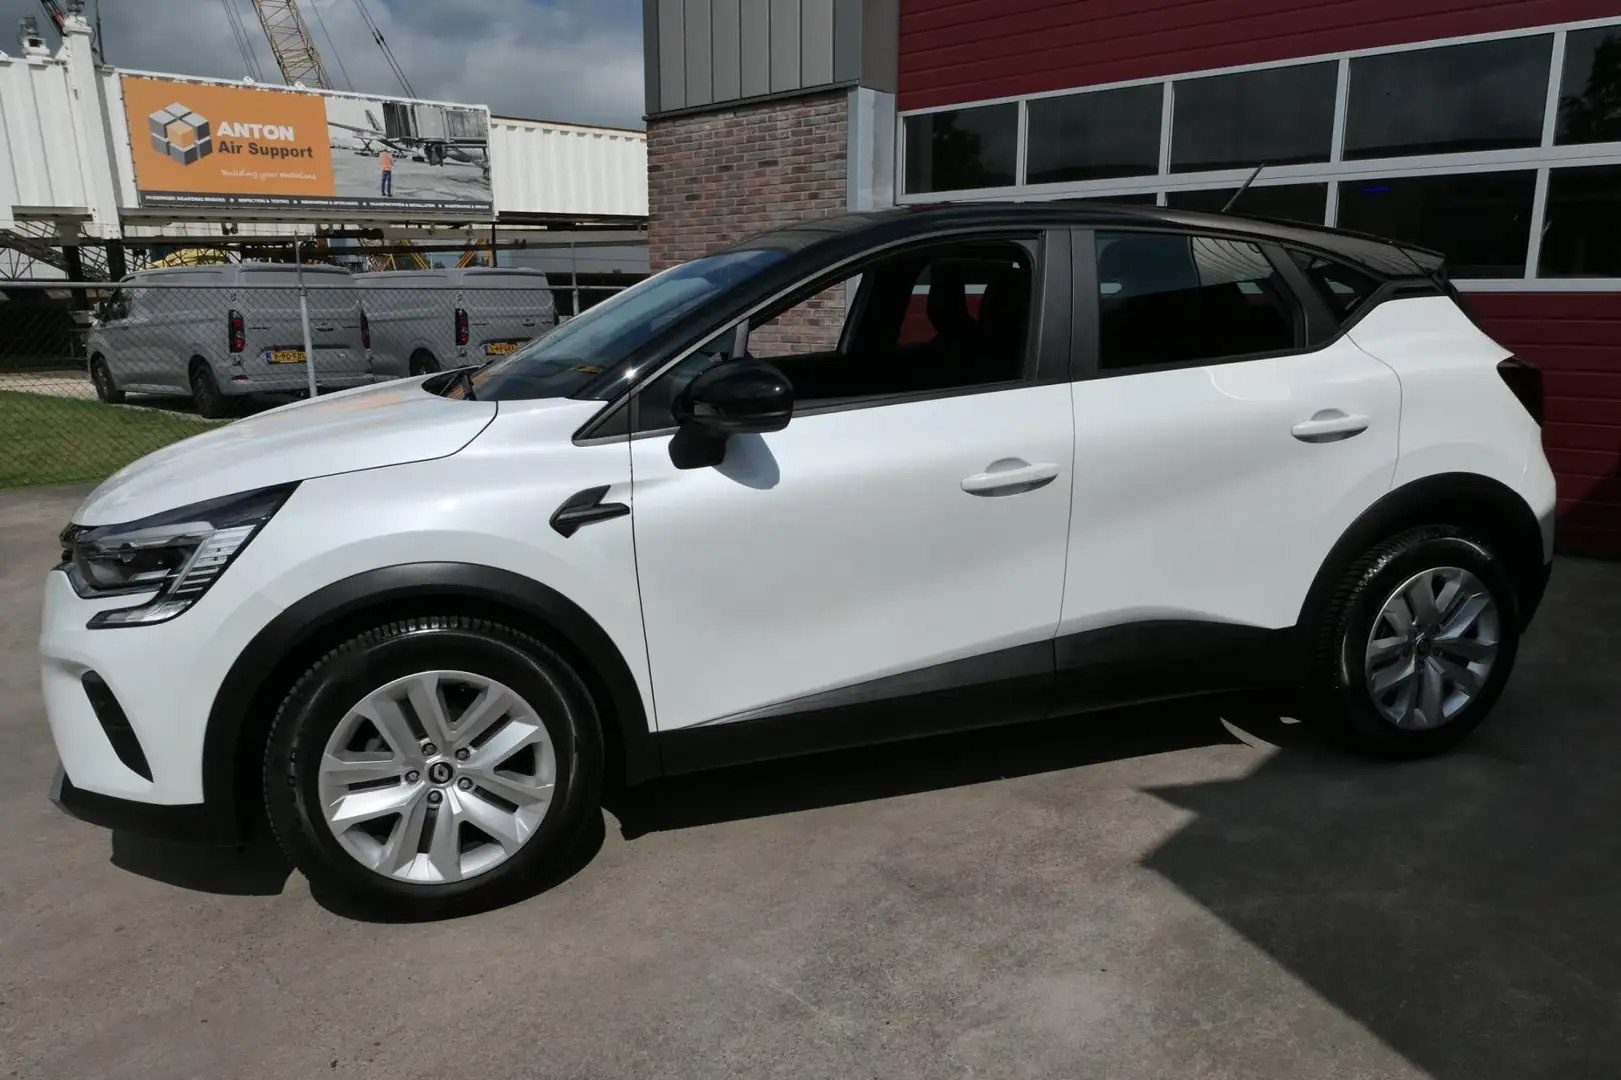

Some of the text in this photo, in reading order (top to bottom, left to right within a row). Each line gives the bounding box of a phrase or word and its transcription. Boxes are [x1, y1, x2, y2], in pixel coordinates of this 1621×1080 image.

[216, 121, 295, 142] ANTON
[218, 140, 314, 160] Air Support
[220, 168, 258, 179] Building
[259, 171, 278, 181] your
